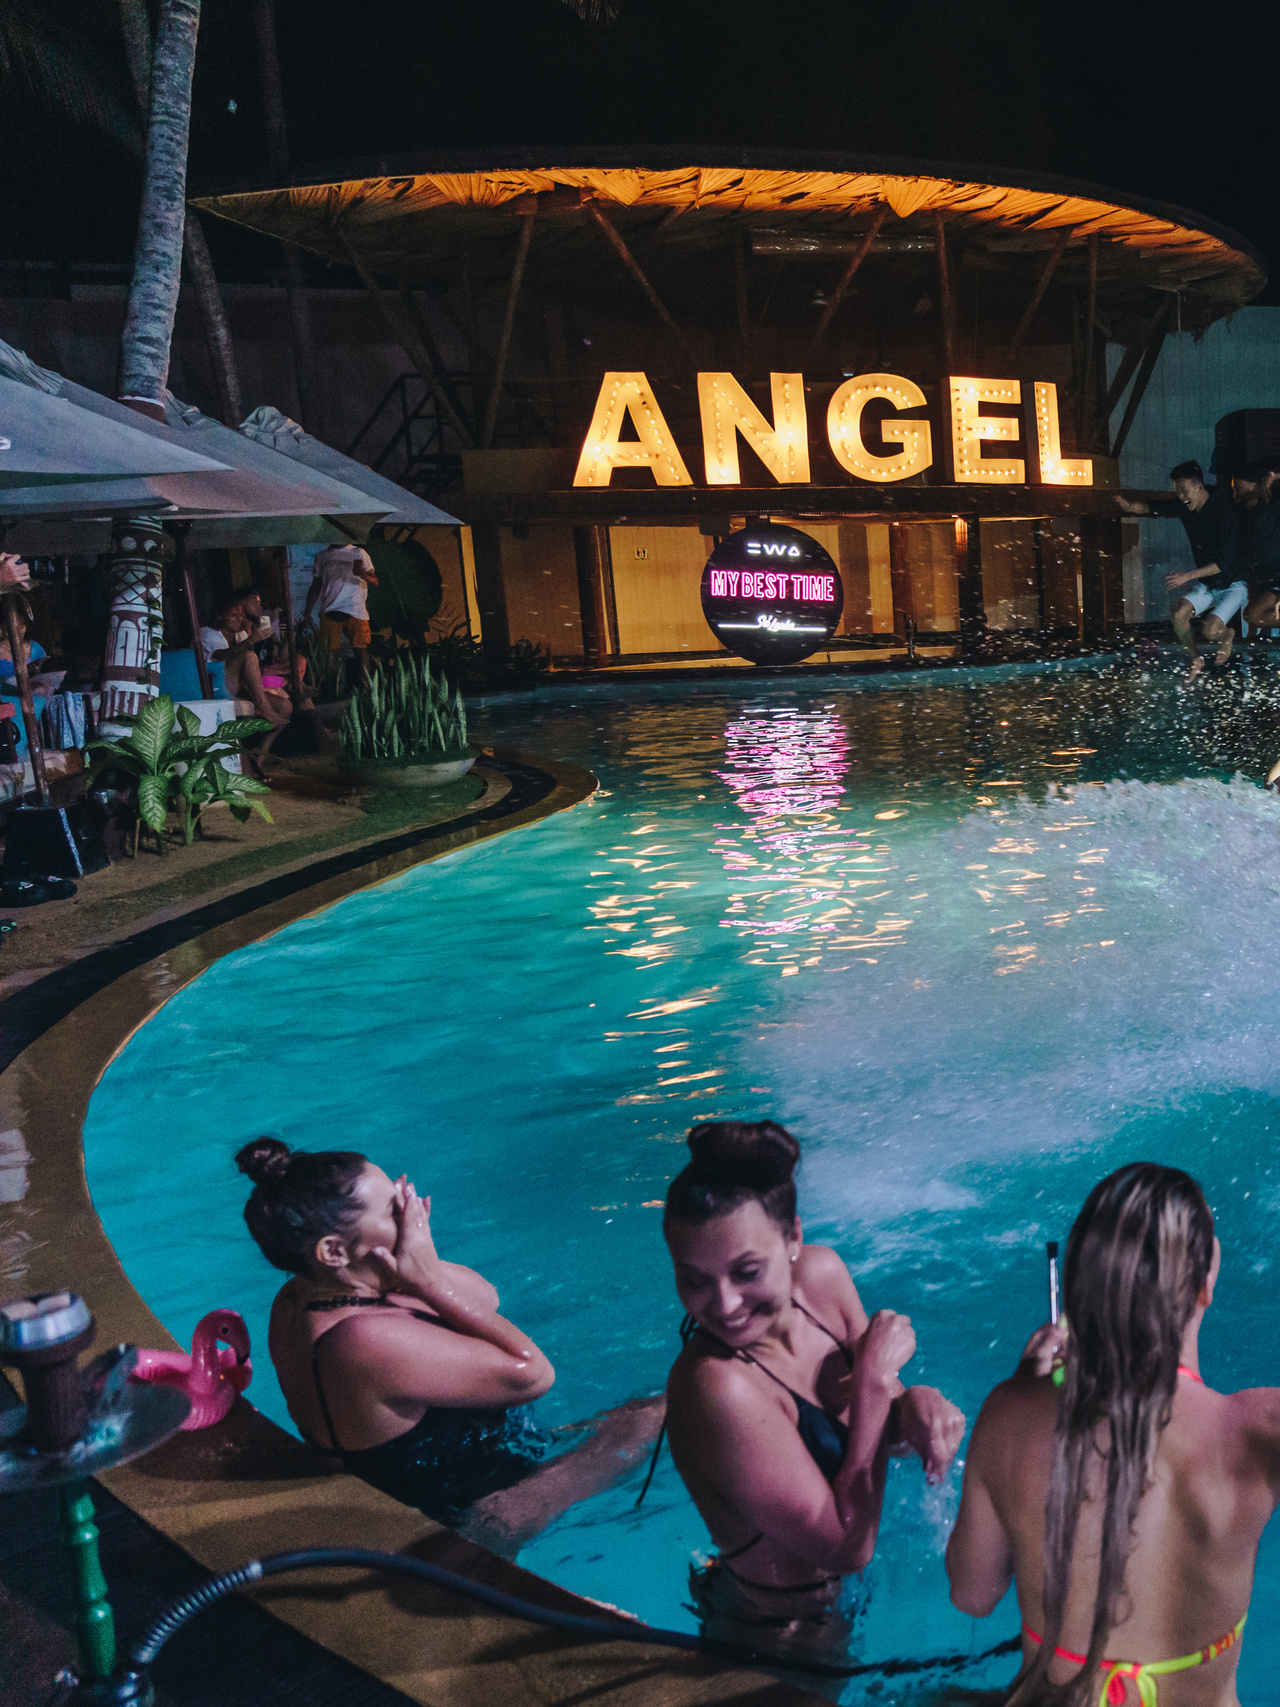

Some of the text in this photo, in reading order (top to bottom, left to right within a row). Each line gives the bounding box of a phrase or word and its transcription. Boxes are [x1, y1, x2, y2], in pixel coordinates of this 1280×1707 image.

[573, 371, 1094, 487] ANGEL
[711, 570, 835, 601] MY BEST TIME
